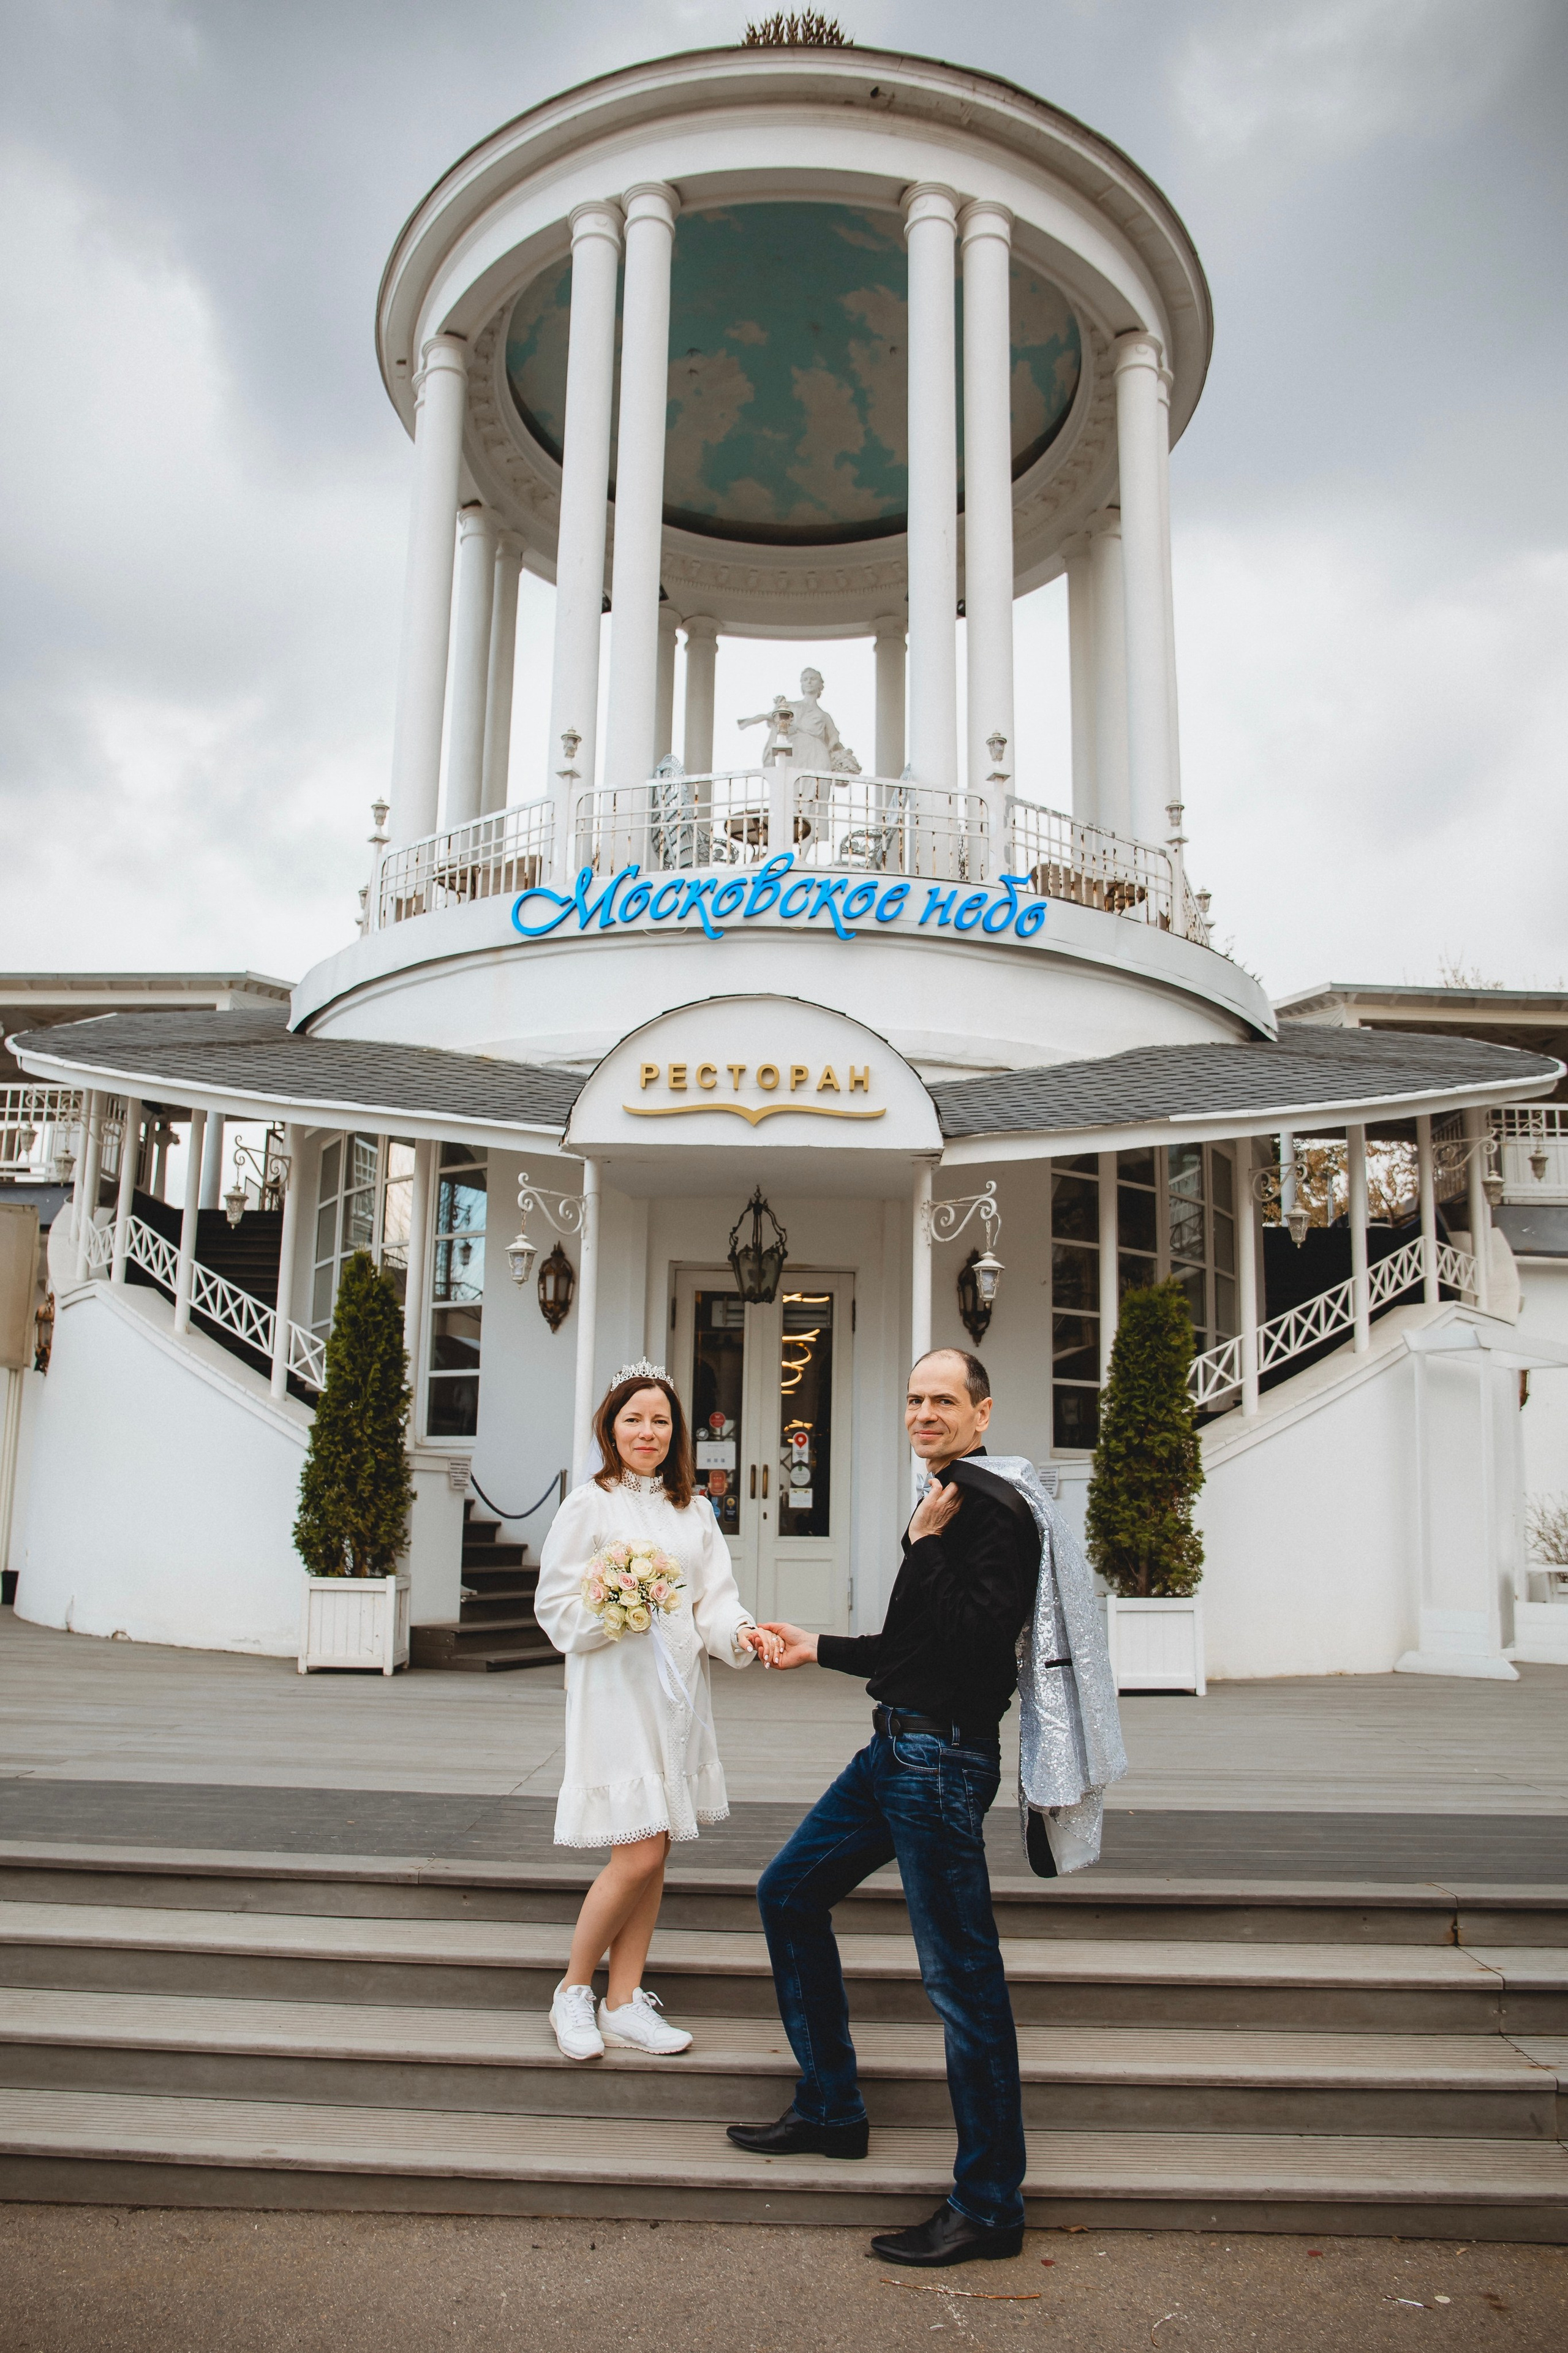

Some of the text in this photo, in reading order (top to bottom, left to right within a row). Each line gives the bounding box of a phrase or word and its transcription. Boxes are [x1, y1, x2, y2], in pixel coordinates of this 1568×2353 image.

[511, 853, 1047, 940] Московское небо
[641, 1063, 870, 1092] РЕСТОРАН
